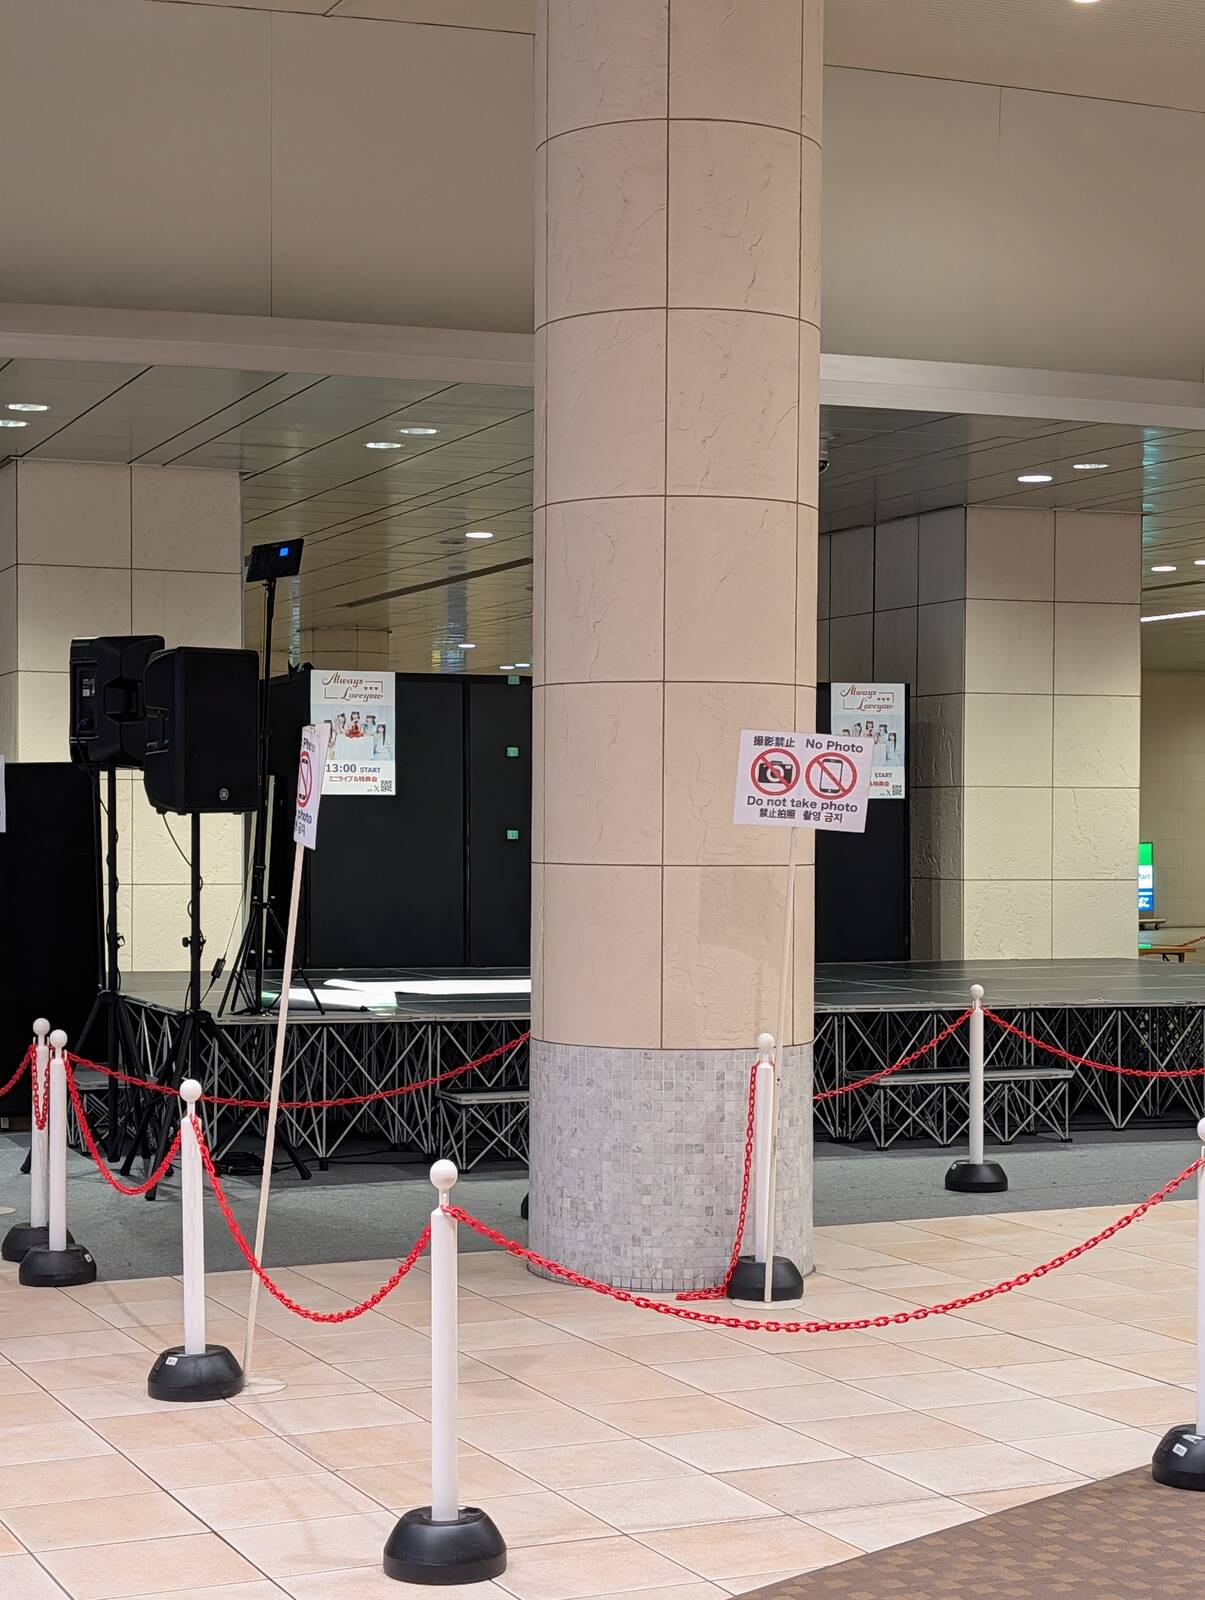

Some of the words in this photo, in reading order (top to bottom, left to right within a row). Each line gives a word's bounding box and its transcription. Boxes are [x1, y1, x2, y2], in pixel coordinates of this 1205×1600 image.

[322, 672, 363, 688] Always
[840, 685, 877, 699] Always
[753, 735, 796, 748] 撮影禁止
[805, 738, 823, 749] No
[826, 740, 864, 754] Photo
[325, 763, 357, 773] 13:00
[360, 766, 381, 774] START
[747, 795, 763, 807] Do
[766, 797, 788, 808] not
[791, 798, 818, 809] take
[820, 800, 858, 814] photo
[759, 808, 796, 820] 禁止拍照
[824, 812, 843, 824] 금지
